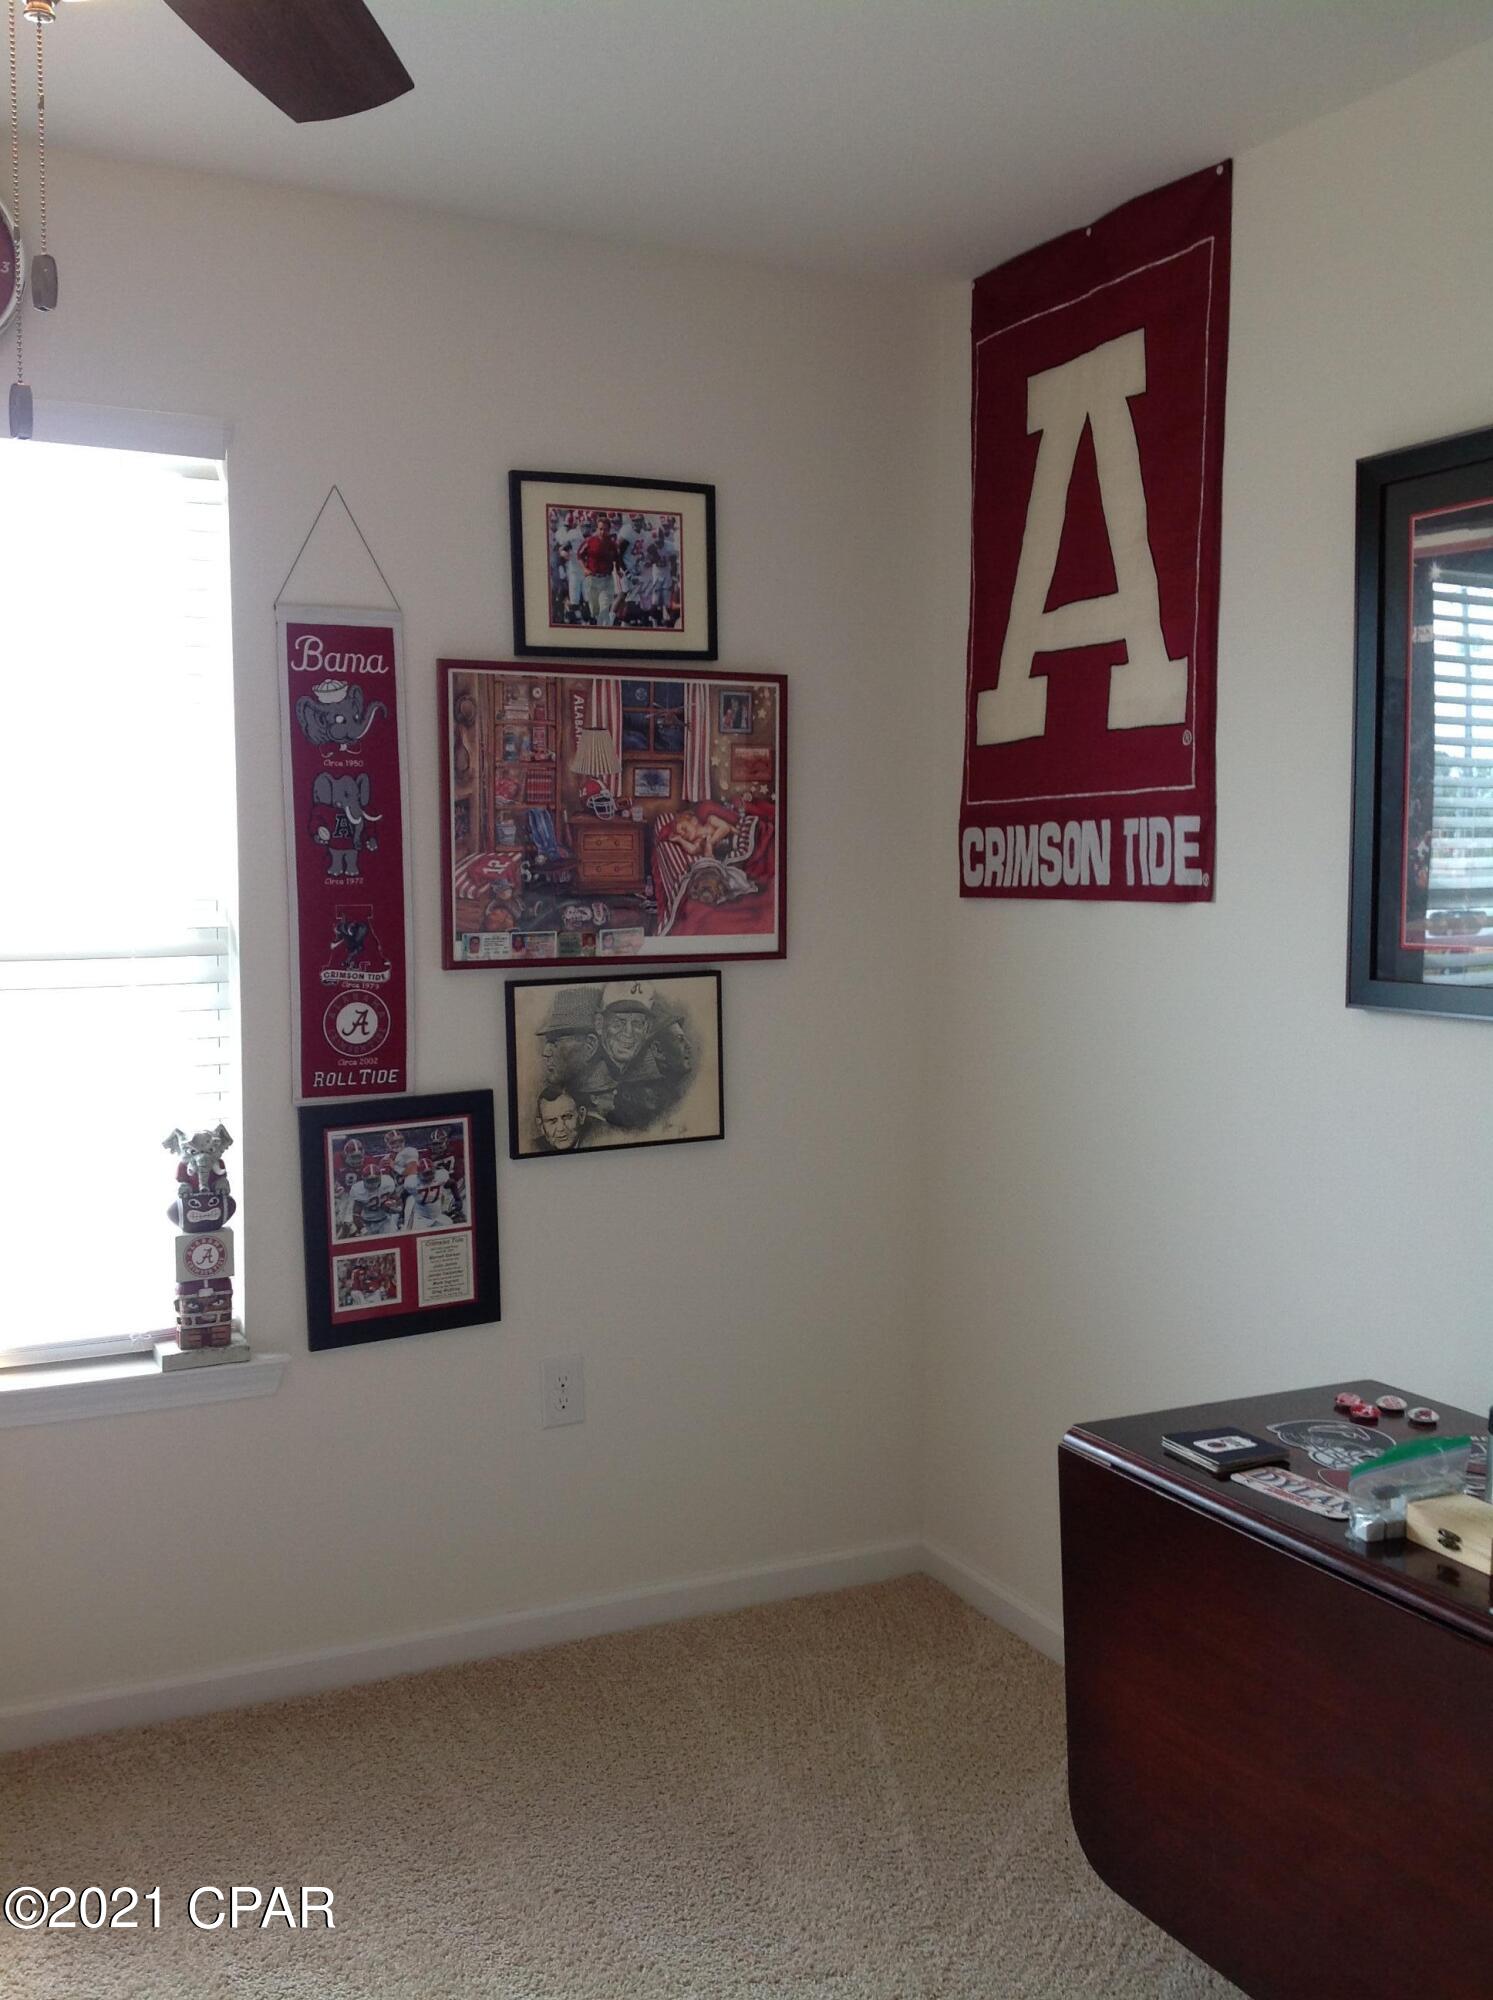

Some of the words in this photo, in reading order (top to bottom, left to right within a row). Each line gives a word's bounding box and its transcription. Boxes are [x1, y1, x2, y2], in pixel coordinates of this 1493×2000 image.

[976, 326, 1189, 747] A
[290, 634, 390, 674] Bama
[323, 758, 344, 768] Circa
[962, 819, 1111, 888] CRIMSON
[1123, 815, 1203, 887] TIDE
[323, 971, 366, 981] CRIMSON
[341, 1009, 370, 1037] A
[312, 1071, 357, 1088] ROLL
[359, 1068, 400, 1085] TIDE
[416, 1185, 441, 1205] 77
[195, 1248, 214, 1265] A
